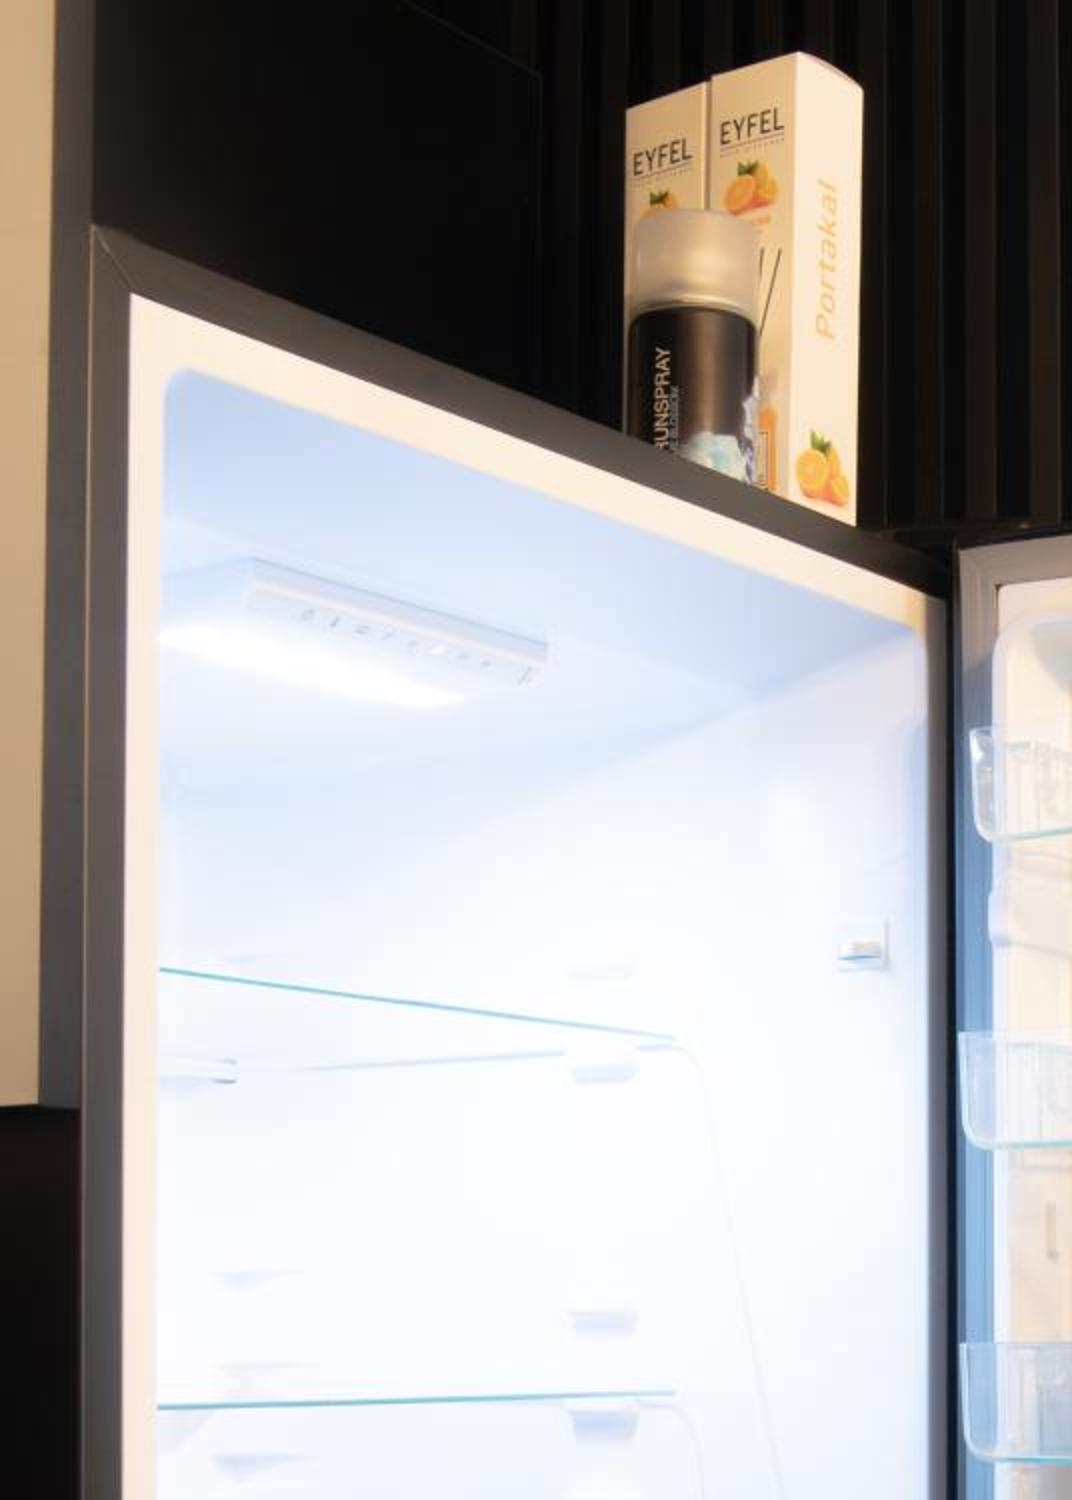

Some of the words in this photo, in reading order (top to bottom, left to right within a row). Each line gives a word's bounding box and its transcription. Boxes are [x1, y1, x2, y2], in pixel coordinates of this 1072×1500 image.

[720, 107, 784, 146] EYFEL
[633, 138, 693, 176] EYFEL
[815, 179, 837, 340] Portakal
